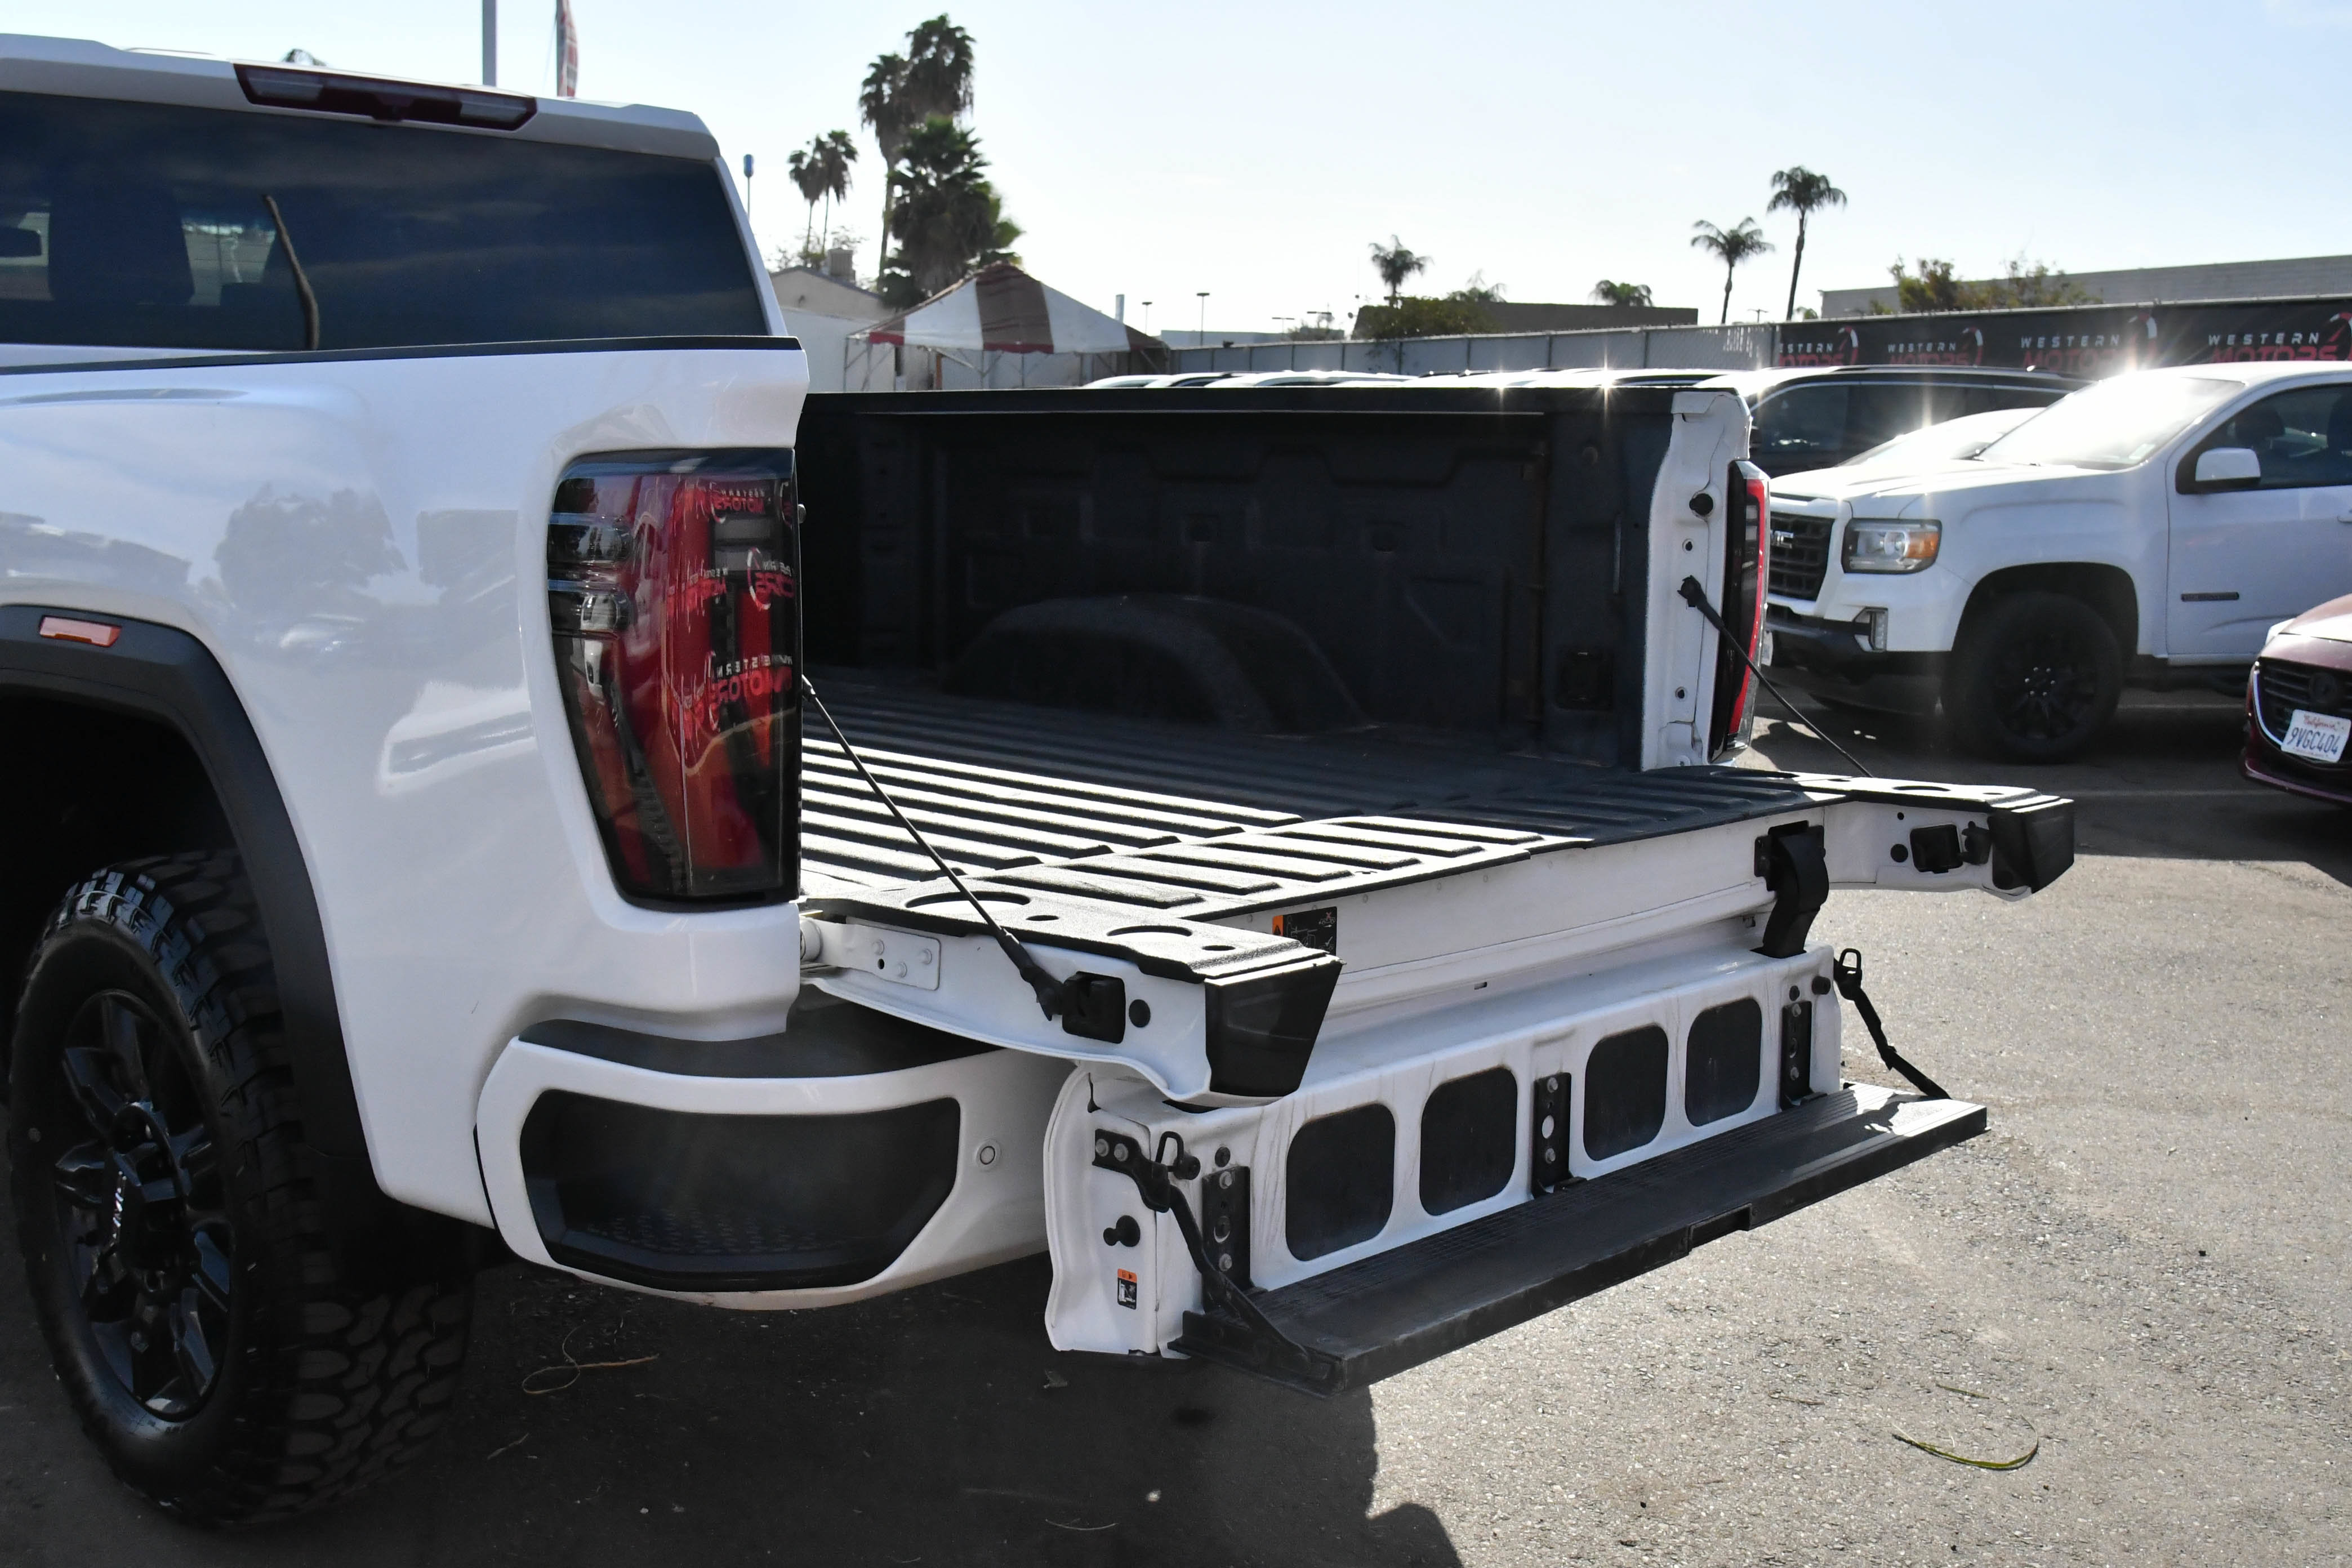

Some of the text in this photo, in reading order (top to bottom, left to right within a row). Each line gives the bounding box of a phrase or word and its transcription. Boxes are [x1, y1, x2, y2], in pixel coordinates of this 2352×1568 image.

[2021, 334, 2120, 349] WESTERN
[2208, 332, 2319, 346] WESTERN
[1779, 342, 1833, 354] ESTERN
[1888, 341, 1956, 353] WESTERN
[2211, 345, 2338, 362] MOTORS
[1779, 354, 1844, 368] OTORS
[2287, 727, 2341, 754] 9VGC404
